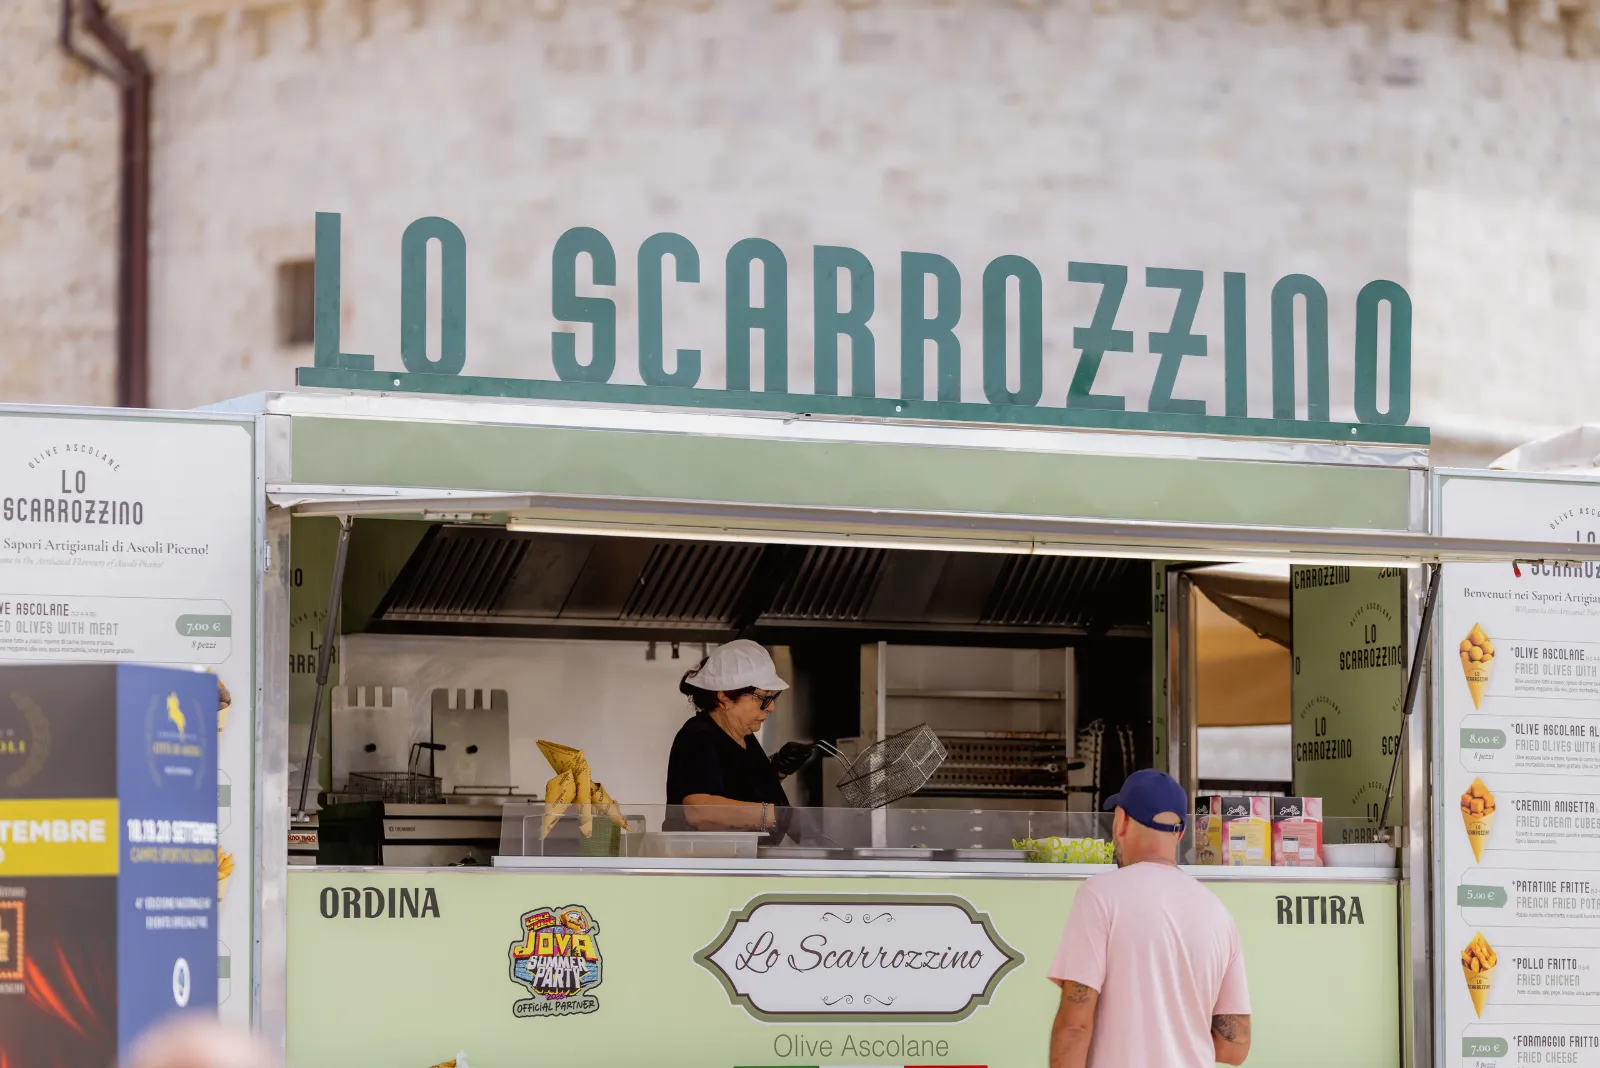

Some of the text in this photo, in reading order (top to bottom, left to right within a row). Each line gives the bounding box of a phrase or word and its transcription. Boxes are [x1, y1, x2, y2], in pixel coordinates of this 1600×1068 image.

[315, 212, 1413, 427] LO SCARROZZINO
[28, 443, 121, 472] OLIVE ASCOLANE
[61, 469, 86, 494] LO
[3, 497, 143, 525] SCARROZZINO
[1549, 509, 1574, 530] OLIVE
[3, 538, 209, 555] Sapori Artigianali di Ascoli Piceno!
[1295, 566, 1350, 589] CARROZZINO
[1464, 587, 1600, 606] Benvenuti nei Sapori Artigia
[16, 602, 69, 616] ASCOLANE
[16, 620, 53, 634] OLIVES
[58, 621, 84, 635] WITH
[89, 622, 119, 636] MEAT
[186, 621, 221, 634] 7.00 €
[1364, 624, 1377, 644] LO
[191, 640, 216, 651] 8 pezzi
[1543, 648, 1585, 660] ASCOLANE
[1515, 663, 1596, 677] FRIED OLIVES WITH
[1315, 716, 1326, 737] LO
[1543, 724, 1585, 737] ASCOLANE
[1469, 734, 1500, 744] 8.00 €
[1516, 739, 1596, 753] FRIED OLIVES WITH
[1297, 738, 1352, 762] CARROZZINO
[1478, 752, 1495, 761] pezzi
[1367, 803, 1379, 823] LO
[1555, 800, 1595, 813] ANISETTA
[1516, 815, 1540, 828] FRIED
[1543, 816, 1572, 828] CREAM
[0, 819, 106, 843] TEMBRE
[1467, 890, 1495, 900] 5.00 €
[1560, 881, 1590, 894] FRITTE
[319, 886, 440, 919] ORDINA
[1275, 895, 1365, 925] RITIRA
[1516, 896, 1600, 910] FRENCH FRIED POTA
[513, 931, 598, 961] JOVA
[735, 931, 984, 974] Lo Scarrozzino
[527, 955, 588, 972] SUMMER
[1548, 958, 1577, 970] FRITTO
[533, 966, 581, 988] PARTY
[1517, 973, 1580, 986] FRIED CHICKEN
[556, 1000, 595, 1011] PARTNER
[773, 1033, 949, 1058] Olive Ascolane
[1471, 1044, 1500, 1055] 7.00 €
[1569, 1036, 1599, 1048] FRITTO
[1517, 1051, 1578, 1064] FRIED CHEESE
